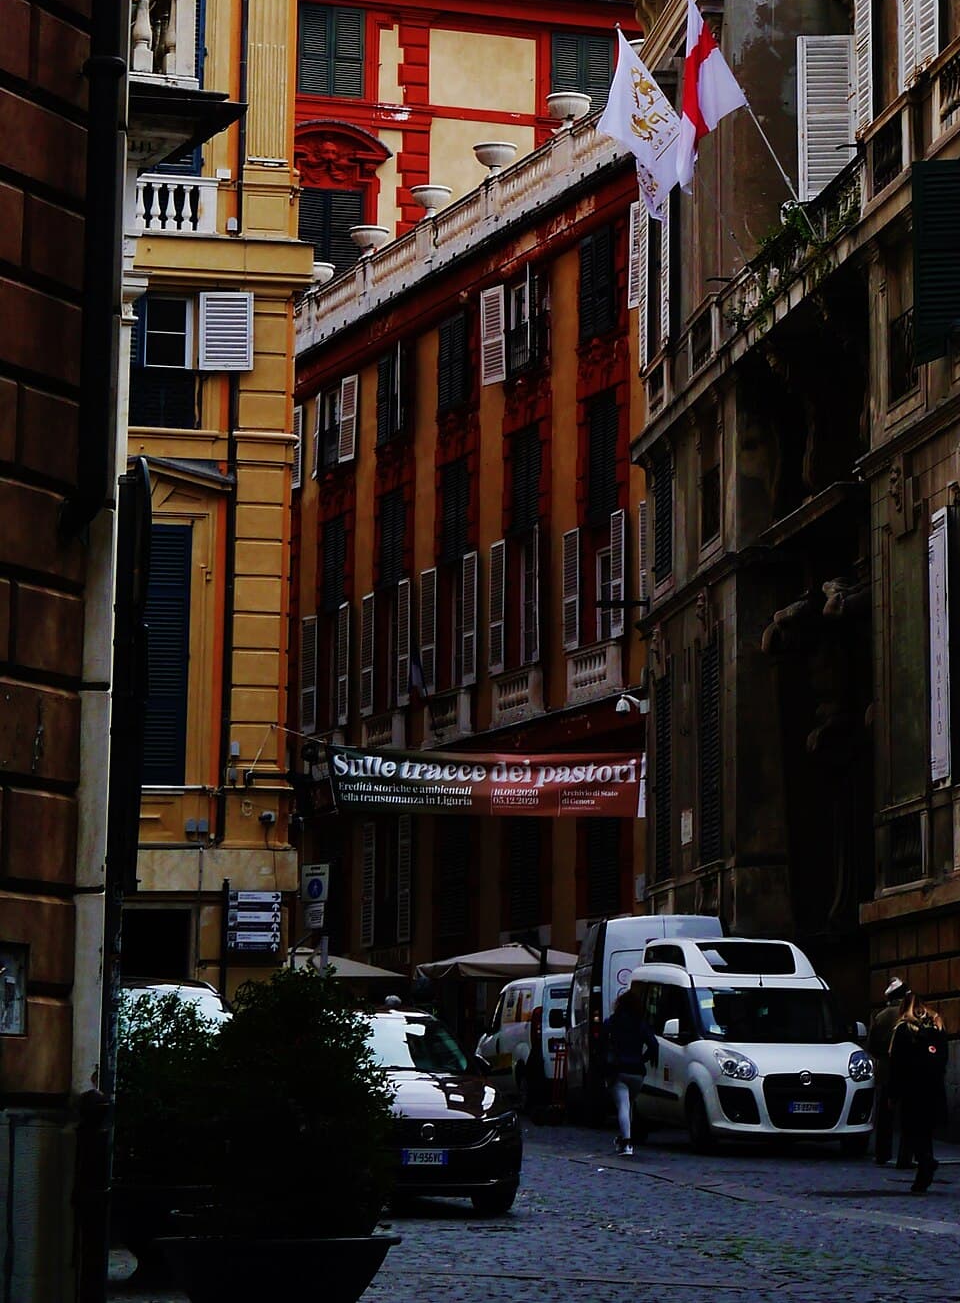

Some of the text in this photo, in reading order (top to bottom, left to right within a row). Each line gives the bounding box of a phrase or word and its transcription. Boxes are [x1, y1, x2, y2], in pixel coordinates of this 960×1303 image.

[333, 752, 638, 788] Sulle tracce dei pastori
[338, 781, 473, 796] Eredità storiche e ambientali
[562, 788, 592, 797] Archivio
[592, 789, 600, 797] di
[360, 794, 425, 805] transumanza
[425, 795, 435, 804] in
[436, 796, 473, 807] Liguria
[562, 797, 569, 805] di
